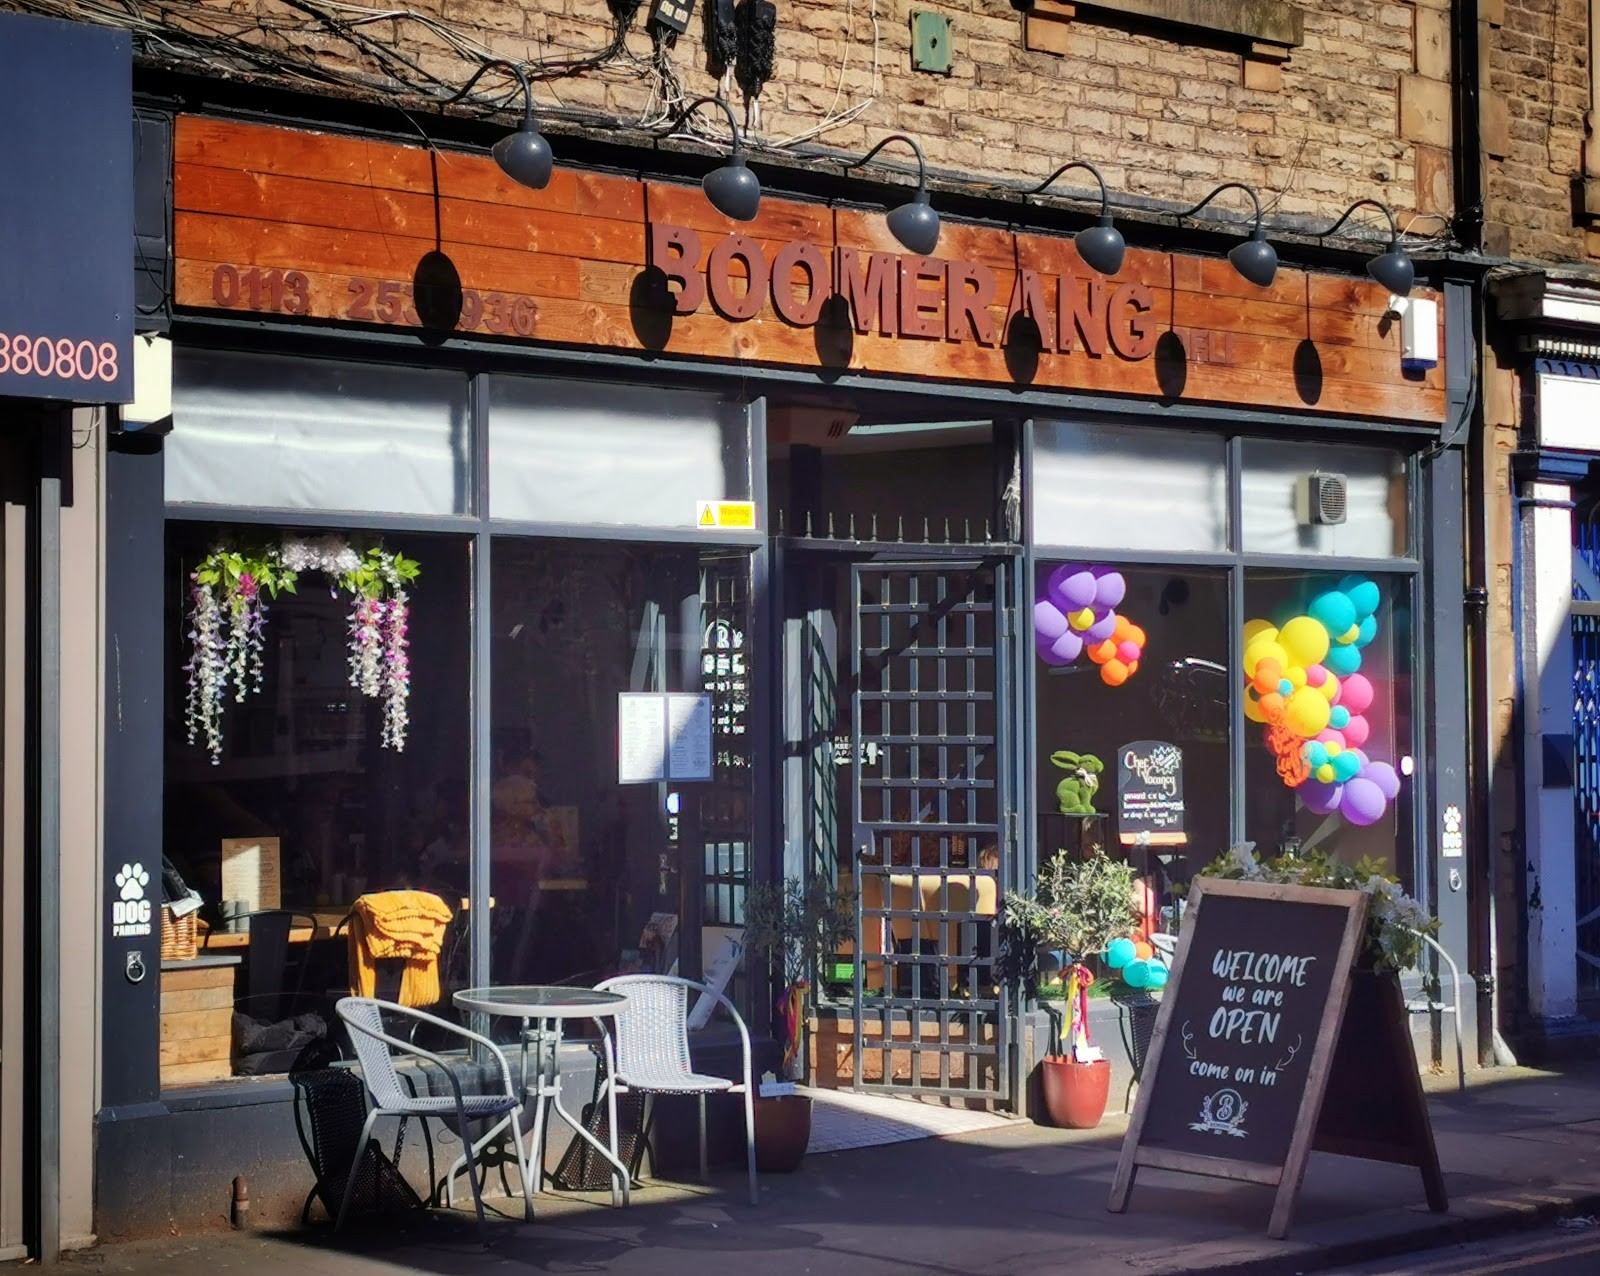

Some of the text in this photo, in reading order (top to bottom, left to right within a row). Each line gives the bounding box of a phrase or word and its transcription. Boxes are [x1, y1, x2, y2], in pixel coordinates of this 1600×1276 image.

[211, 264, 537, 336] 0113 25936
[650, 222, 1157, 361] BOOMERANG
[1125, 751, 1150, 777] Chef
[1141, 766, 1177, 796] Vacancy
[113, 900, 151, 924] DOG
[1212, 949, 1317, 987] WELCOME
[1222, 986, 1284, 1007] we are
[1209, 1006, 1281, 1044] OPEN
[1190, 1060, 1277, 1086] come on in
